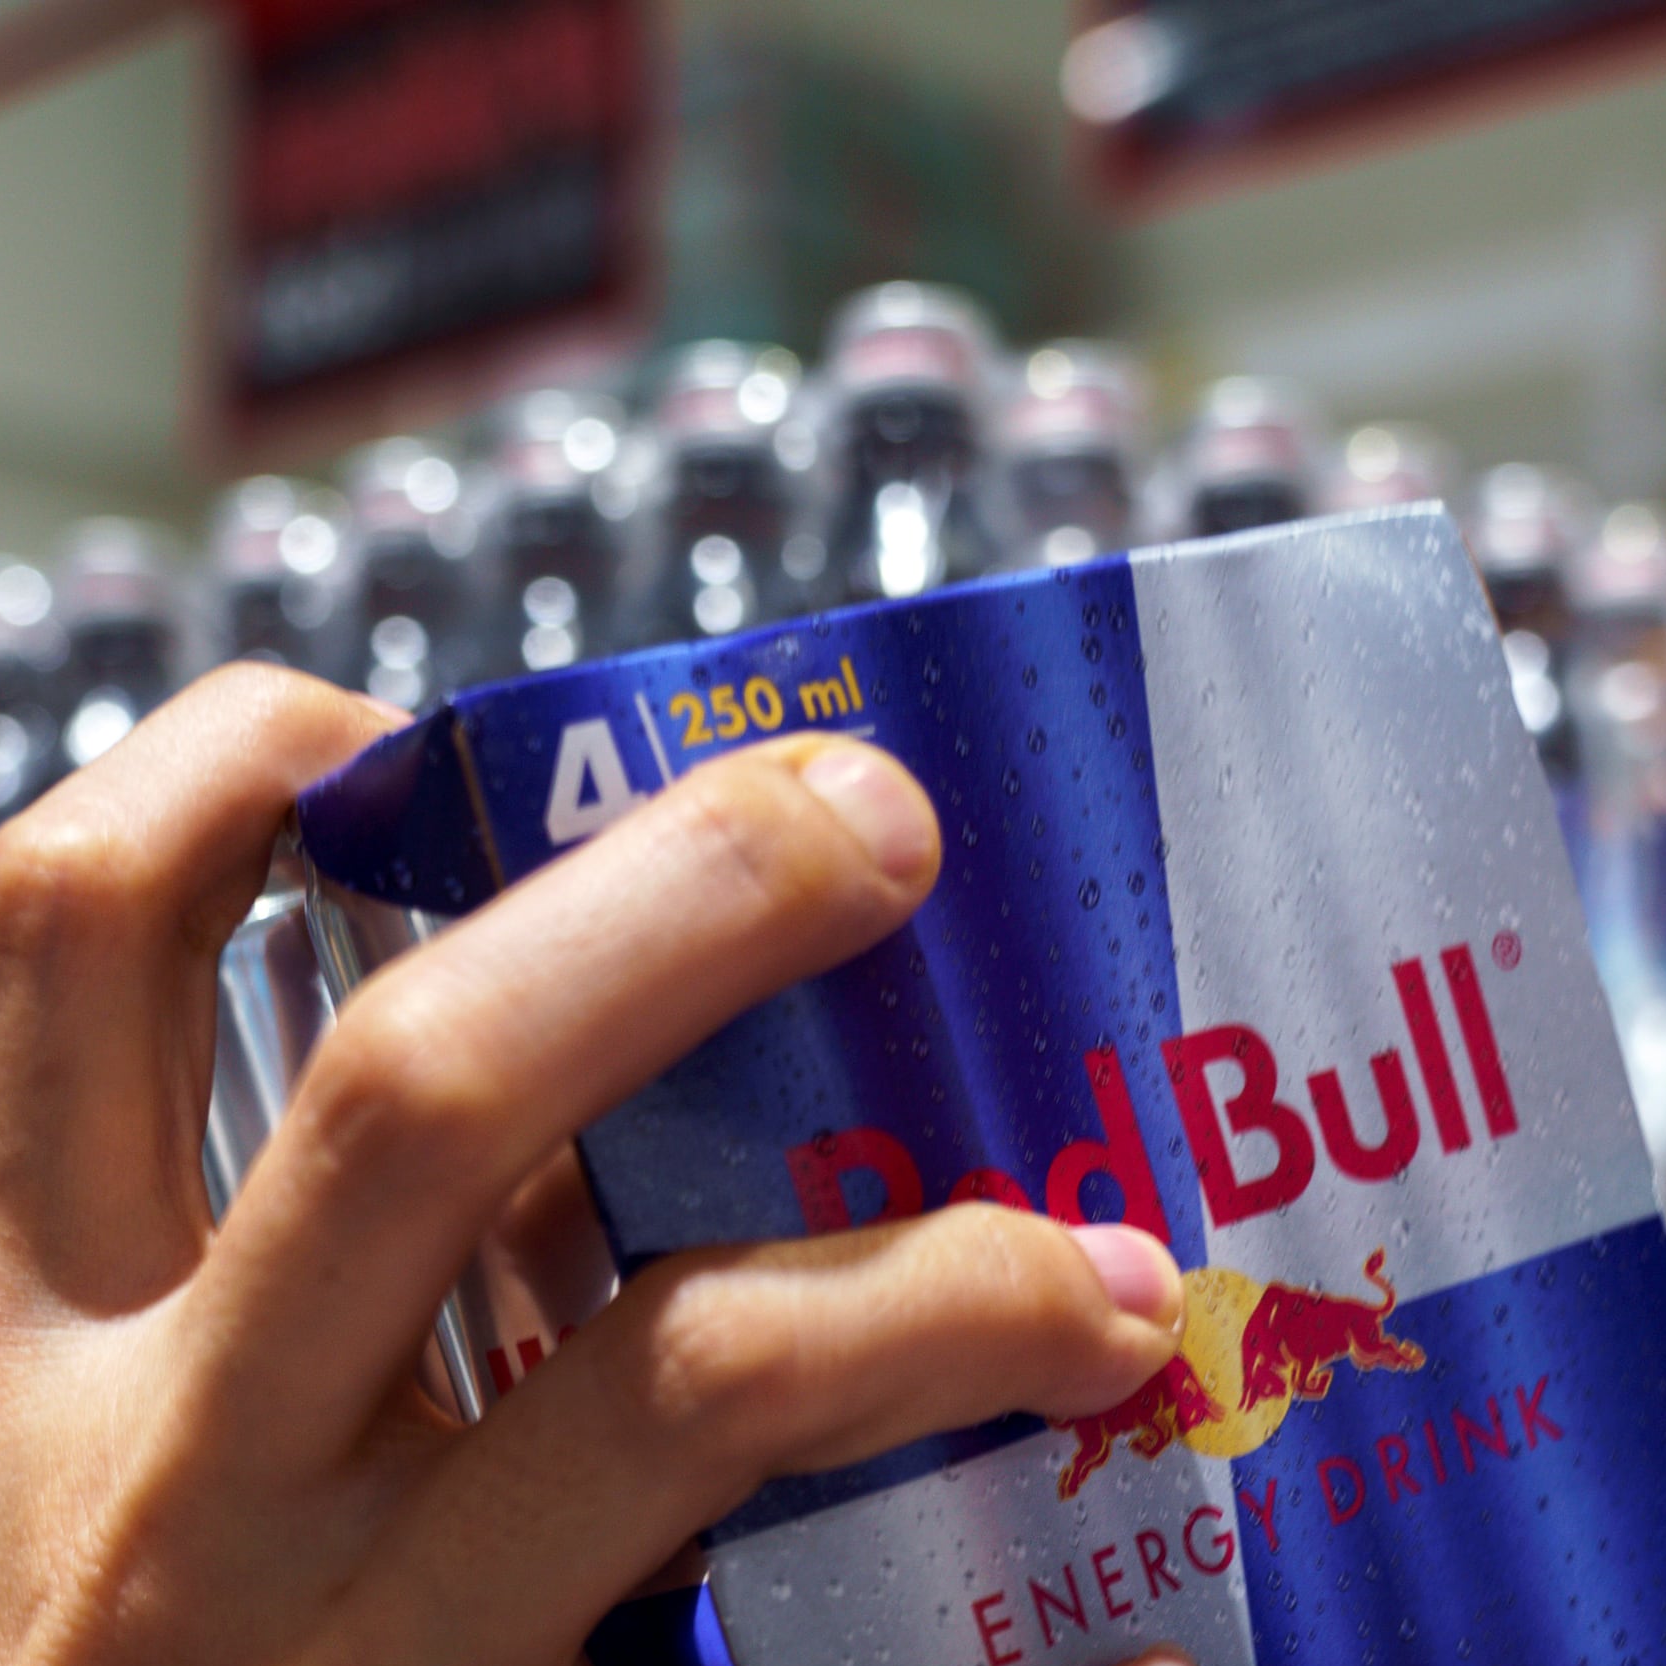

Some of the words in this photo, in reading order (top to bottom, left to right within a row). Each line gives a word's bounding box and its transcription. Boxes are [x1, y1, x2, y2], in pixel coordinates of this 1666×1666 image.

[669, 676, 783, 748] 250
[798, 655, 864, 722] ml
[544, 716, 651, 847] 4
[1160, 942, 1519, 1229] Bull
[1316, 1374, 1564, 1526] DRINK
